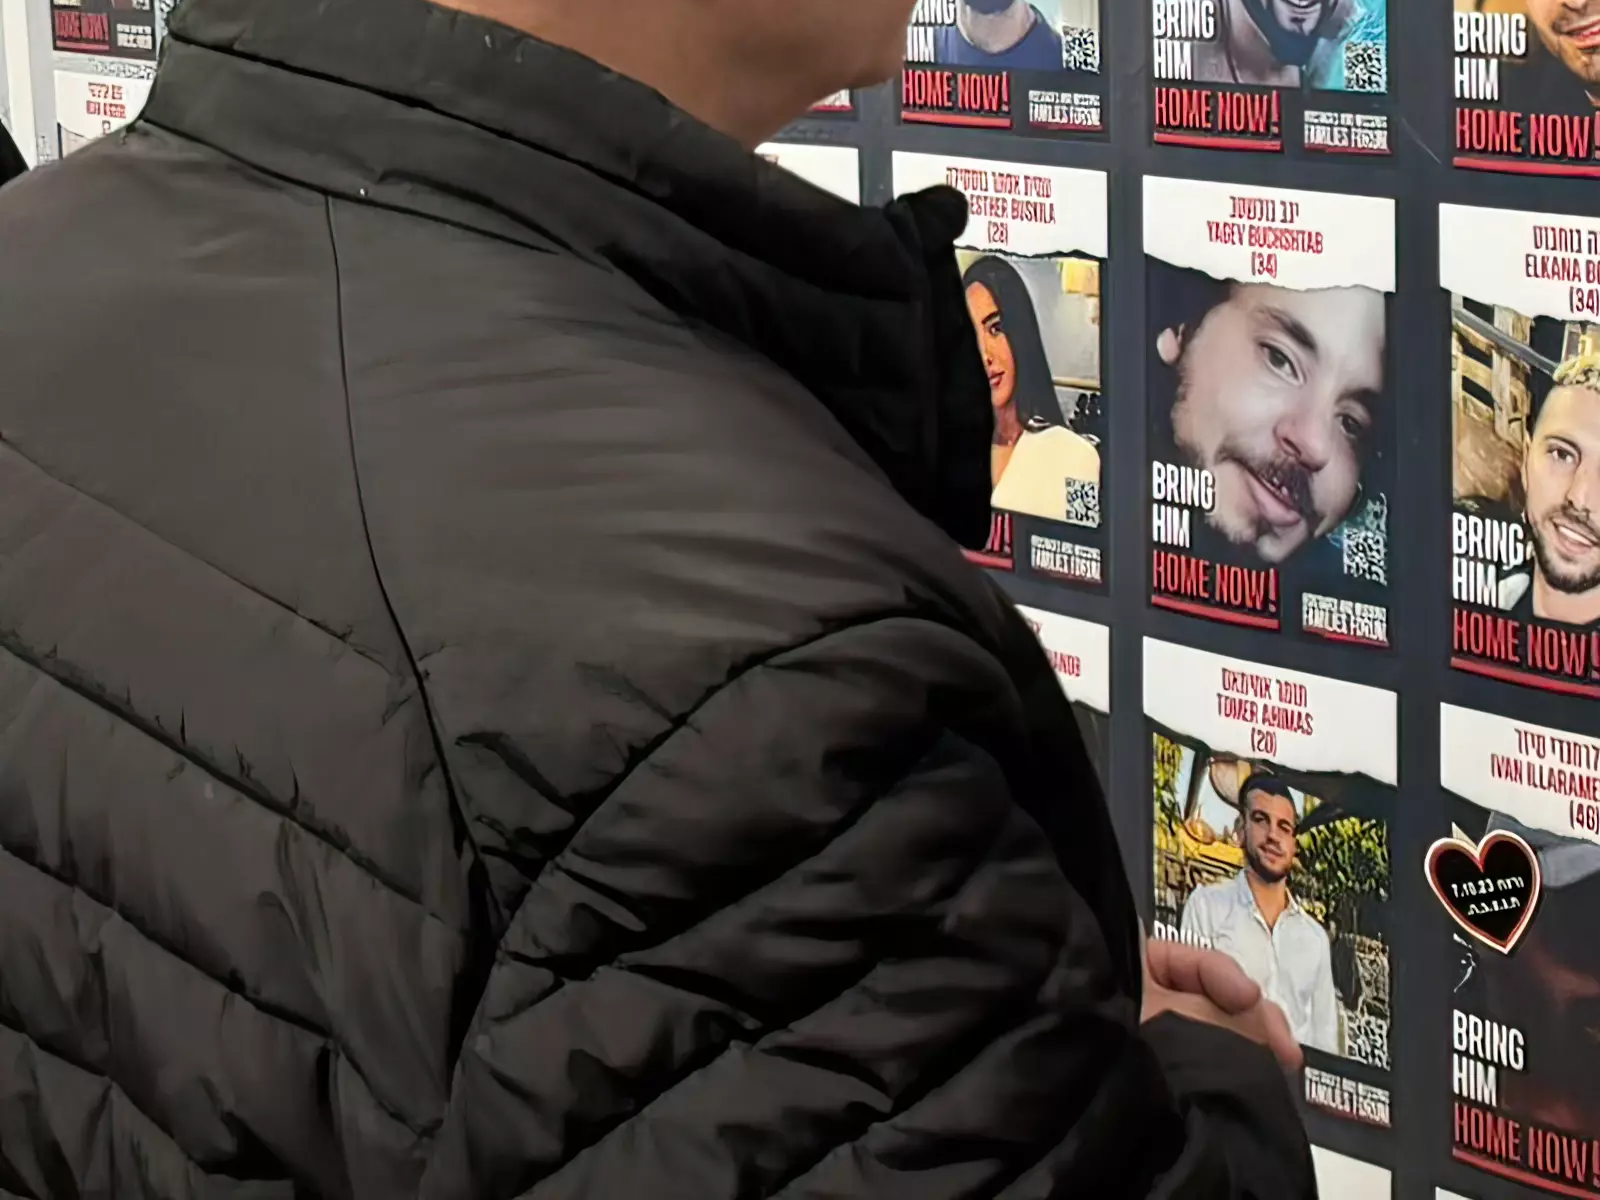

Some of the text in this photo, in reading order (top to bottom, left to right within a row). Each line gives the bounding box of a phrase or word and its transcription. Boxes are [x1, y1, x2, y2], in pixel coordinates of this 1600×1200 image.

[1525, 253, 1582, 282] ELKANA
[1569, 285, 1600, 316] (34)
[1250, 726, 1277, 760] (20)
[1490, 753, 1523, 784] IVAN
